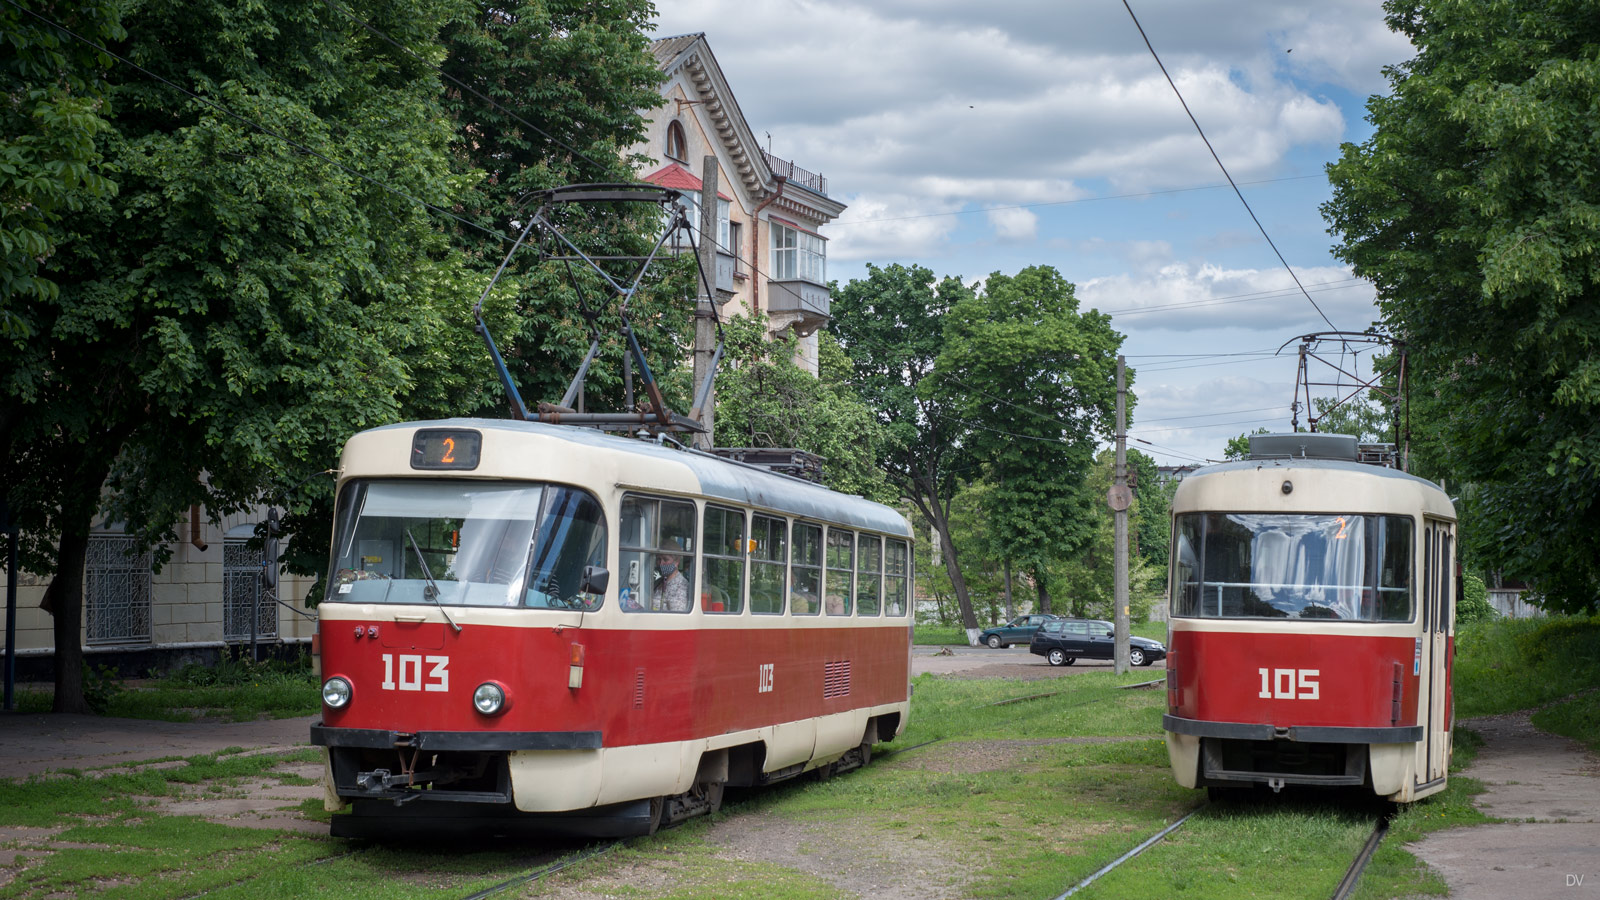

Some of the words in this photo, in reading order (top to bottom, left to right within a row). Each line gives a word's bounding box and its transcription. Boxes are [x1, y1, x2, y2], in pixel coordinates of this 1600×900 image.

[441, 438, 455, 463] 2
[1335, 517, 1347, 539] 2
[381, 653, 449, 692] 103
[758, 663, 774, 693] 103
[1258, 668, 1320, 699] 105
